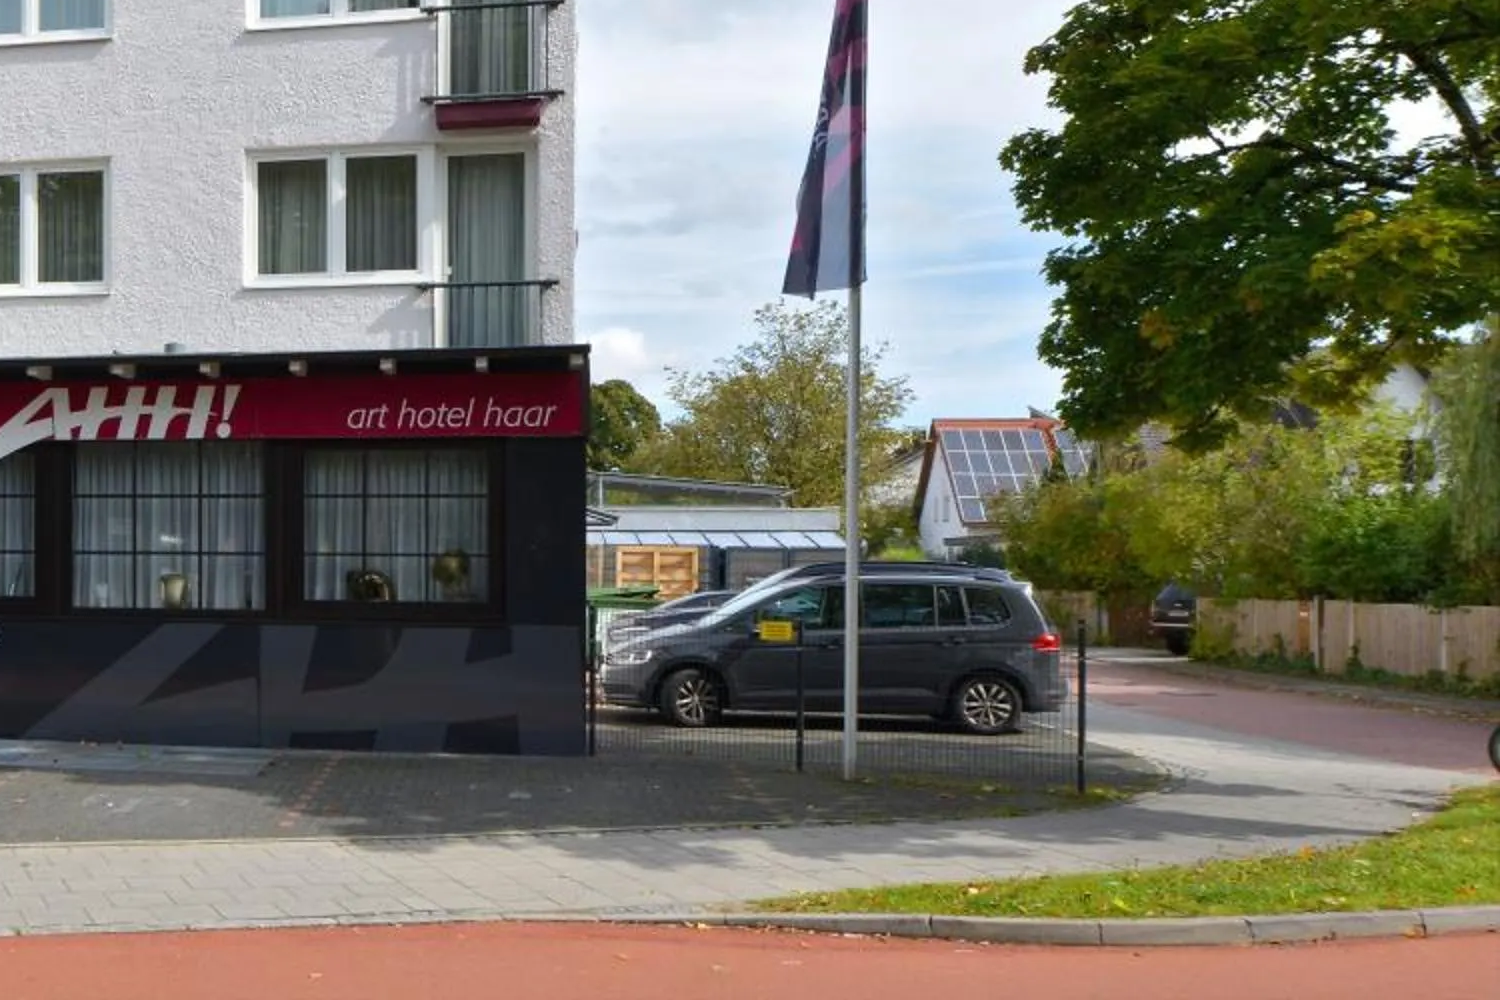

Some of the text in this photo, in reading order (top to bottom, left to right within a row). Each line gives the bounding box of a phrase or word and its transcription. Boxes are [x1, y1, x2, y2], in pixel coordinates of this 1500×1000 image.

[347, 397, 558, 430] art hotel haar
